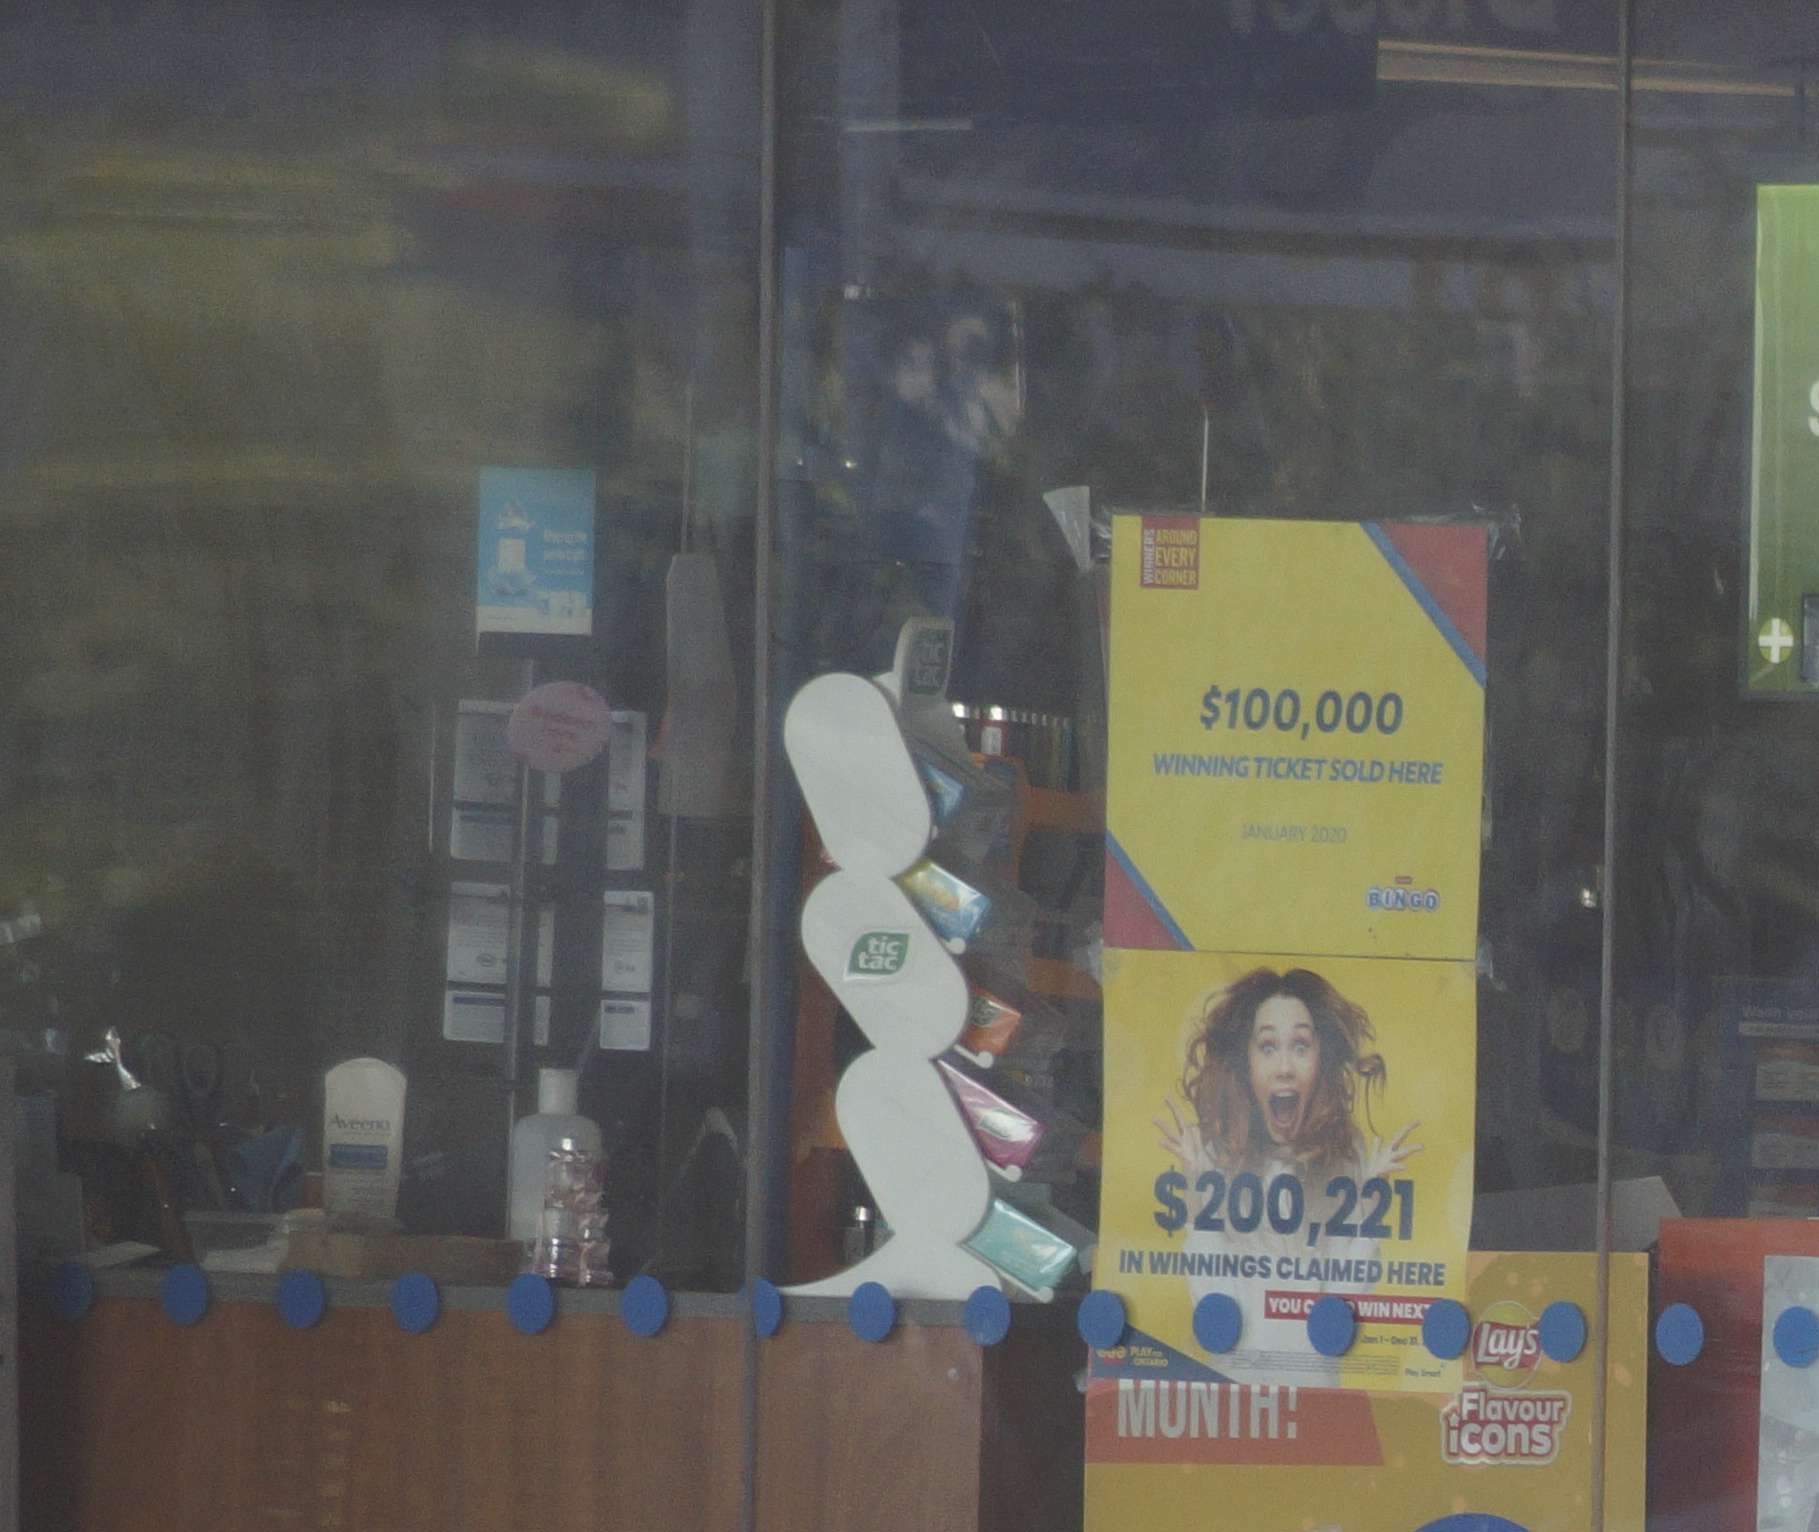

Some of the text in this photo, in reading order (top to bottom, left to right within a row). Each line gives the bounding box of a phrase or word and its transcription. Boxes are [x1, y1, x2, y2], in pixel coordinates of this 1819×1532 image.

[1155, 547, 1197, 567] EVERY
[1154, 568, 1197, 585] CORNER
[1200, 684, 1404, 740] $100,000
[1153, 753, 1443, 785] WINNING TICKET SOLD HERE
[1367, 886, 1440, 912] BINGO
[858, 950, 898, 970] tac
[867, 936, 900, 955] tic
[1153, 1165, 1415, 1248] $200,221
[1119, 1249, 1446, 1287] IN WINNINGS CLAIMED HERE
[1269, 1297, 1301, 1315] YOU
[1358, 1301, 1390, 1319] WIN
[1476, 1322, 1540, 1370] Lay's
[1461, 1392, 1567, 1425] Flavour
[1449, 1411, 1555, 1457] icons
